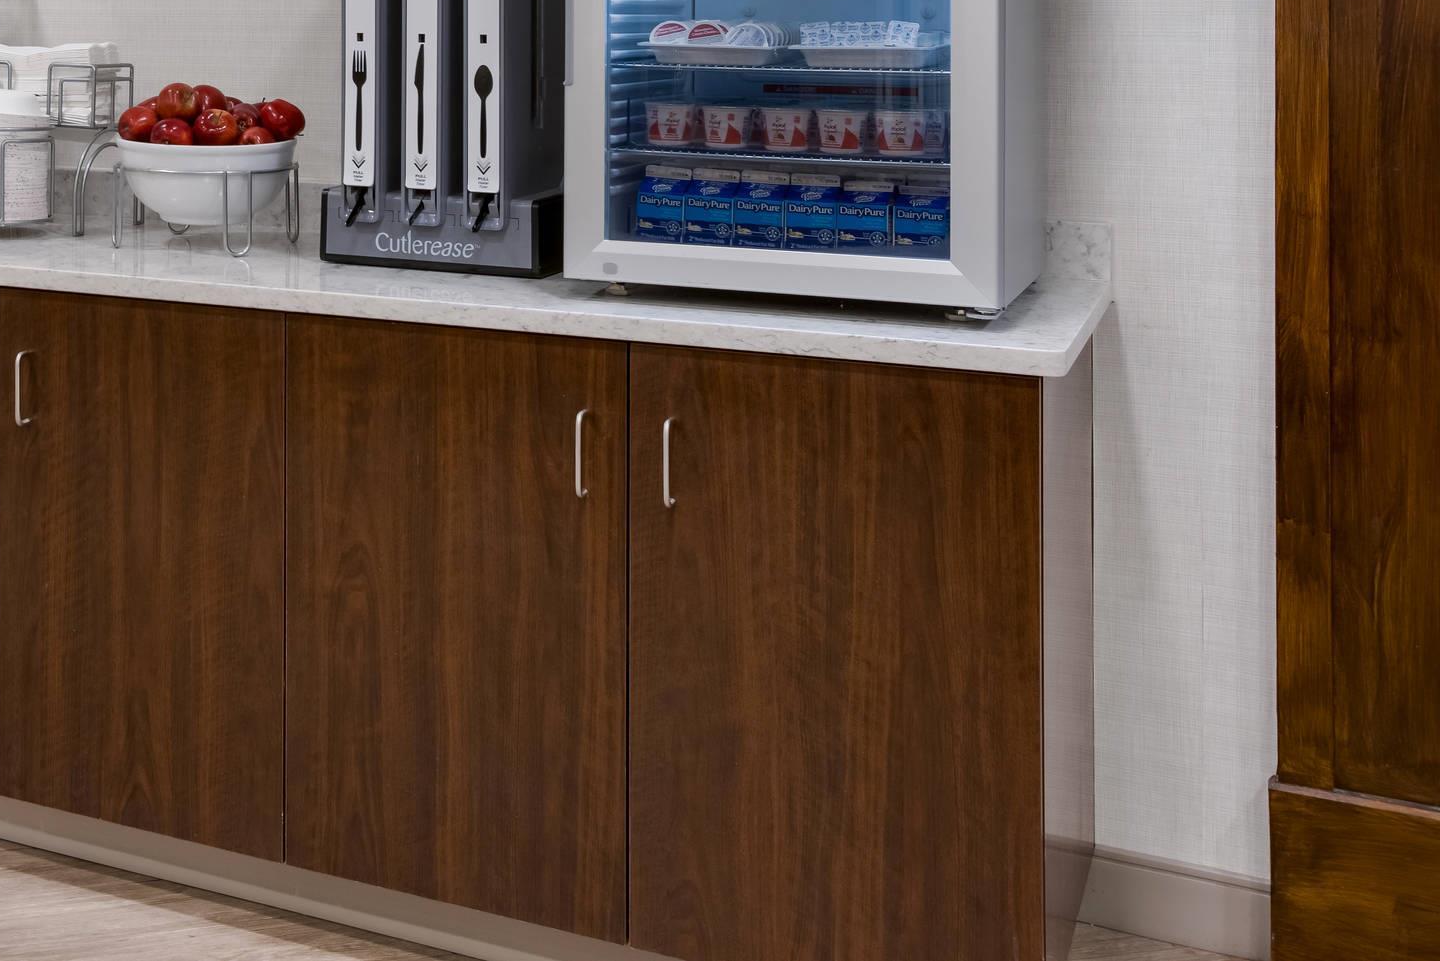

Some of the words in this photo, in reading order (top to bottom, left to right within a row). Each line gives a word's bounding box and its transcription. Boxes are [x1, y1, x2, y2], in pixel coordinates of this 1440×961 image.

[640, 195, 681, 207] DairyPure
[688, 198, 730, 210] DairyPure
[737, 200, 780, 213] DairyPure
[788, 203, 833, 215] DairyPure
[839, 206, 885, 218] DairyPure
[897, 209, 944, 221] DairyPure
[375, 230, 474, 258] Cutlerease
